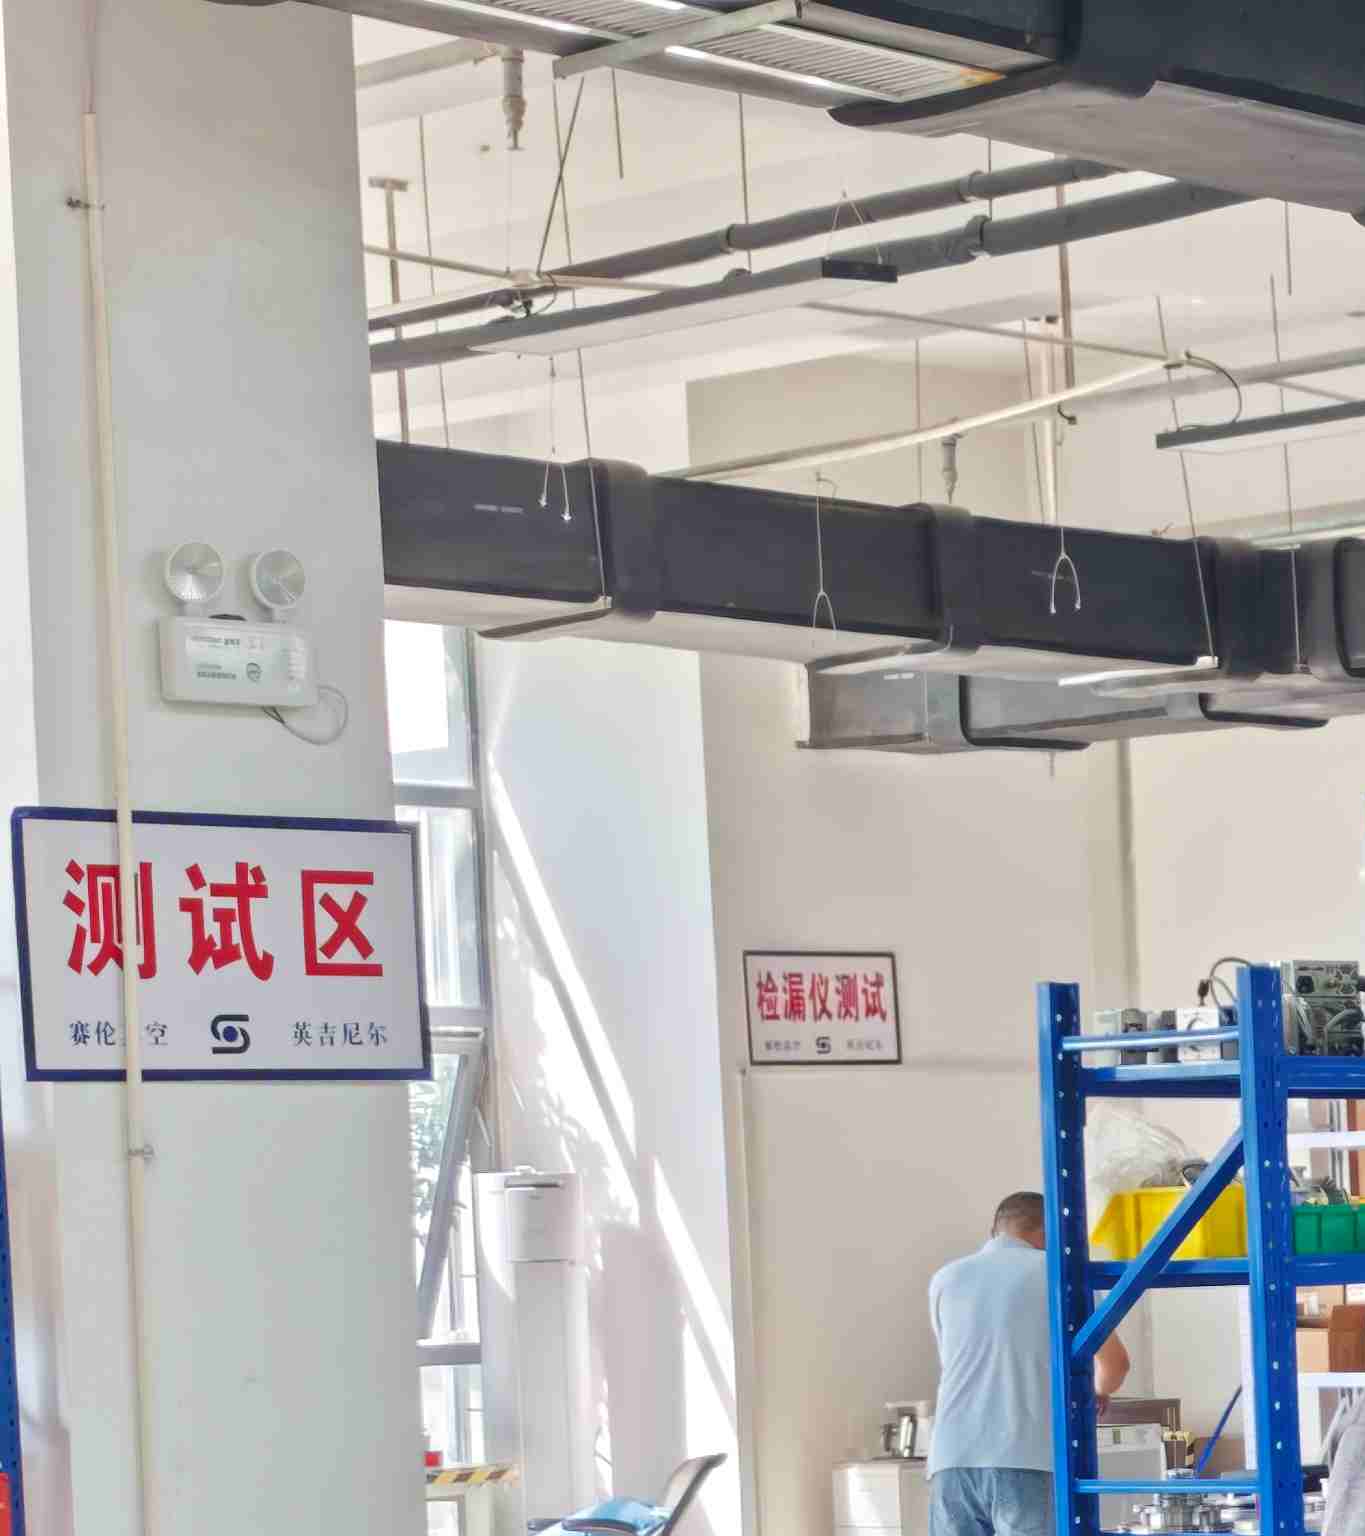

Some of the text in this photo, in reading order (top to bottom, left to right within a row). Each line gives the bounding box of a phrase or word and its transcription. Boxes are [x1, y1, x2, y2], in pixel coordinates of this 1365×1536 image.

[63, 859, 384, 981] 测试区
[756, 971, 888, 1022] 检漏仪测试
[70, 1020, 389, 1048] 赛伦空 英吉尼尔
